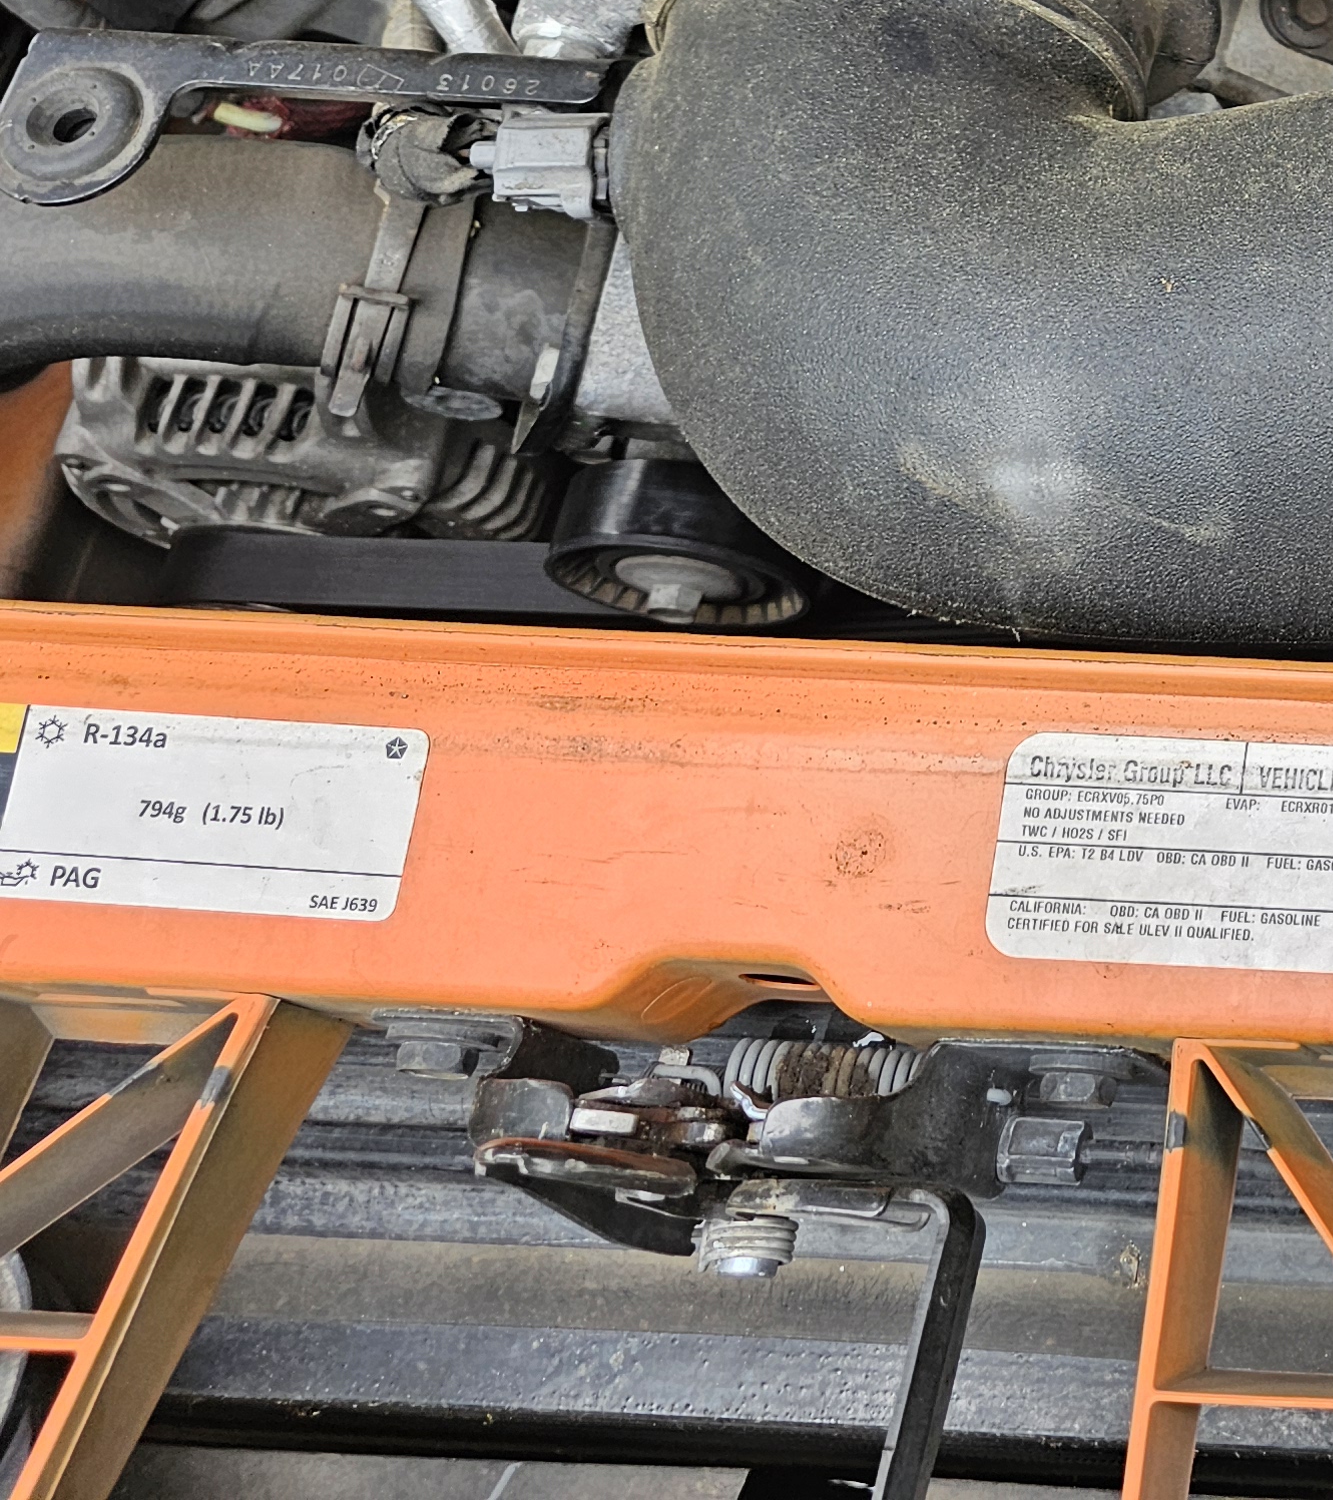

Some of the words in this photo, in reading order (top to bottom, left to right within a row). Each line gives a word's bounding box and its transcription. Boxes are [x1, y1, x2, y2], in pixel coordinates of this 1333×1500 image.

[248, 59, 349, 83] 017AA
[435, 72, 542, 97] 26013
[83, 722, 169, 749] R-134a
[1030, 754, 1117, 784] Chrysler
[1123, 759, 1186, 789] Group
[1194, 762, 1233, 788] LLC
[1025, 787, 1073, 802] GROUP:
[1225, 797, 1261, 812] EVAP:
[138, 799, 188, 825] 794g
[201, 802, 253, 826] (1.75
[257, 806, 286, 831] lb)
[1023, 806, 1041, 819] NO
[1044, 807, 1133, 823] ADJUSTMENTS
[1138, 812, 1185, 826] NEEDED
[1021, 824, 1048, 838] TWC
[1107, 829, 1128, 842] SFI
[1018, 844, 1042, 858] U.S.
[1048, 846, 1076, 860] EPA:
[1081, 847, 1096, 861] T2
[1099, 848, 1115, 862] B4
[1118, 849, 1144, 863] LDV
[1156, 851, 1186, 866] OBD:
[1190, 852, 1207, 866] CA
[1210, 853, 1236, 868] OBD
[1240, 855, 1250, 868] II
[1266, 856, 1302, 871] FUEL:
[49, 865, 102, 890] PAG
[309, 894, 340, 910] SAE
[341, 896, 378, 913] J639
[1009, 899, 1087, 916] CALIFORNIA:
[1109, 904, 1139, 919] OBD:
[1143, 906, 1160, 919] CA
[1164, 907, 1190, 921] OBD
[1194, 909, 1204, 922] II
[1220, 910, 1256, 925] FUEL:
[1260, 912, 1321, 928] GASOLINE
[1007, 917, 1070, 933] CERTIFIED
[1074, 920, 1099, 934] FOR
[1103, 922, 1134, 936] SALE
[1138, 923, 1170, 938] ULEV
[1174, 925, 1183, 938] II
[1186, 926, 1255, 942] QUALIFIED.
